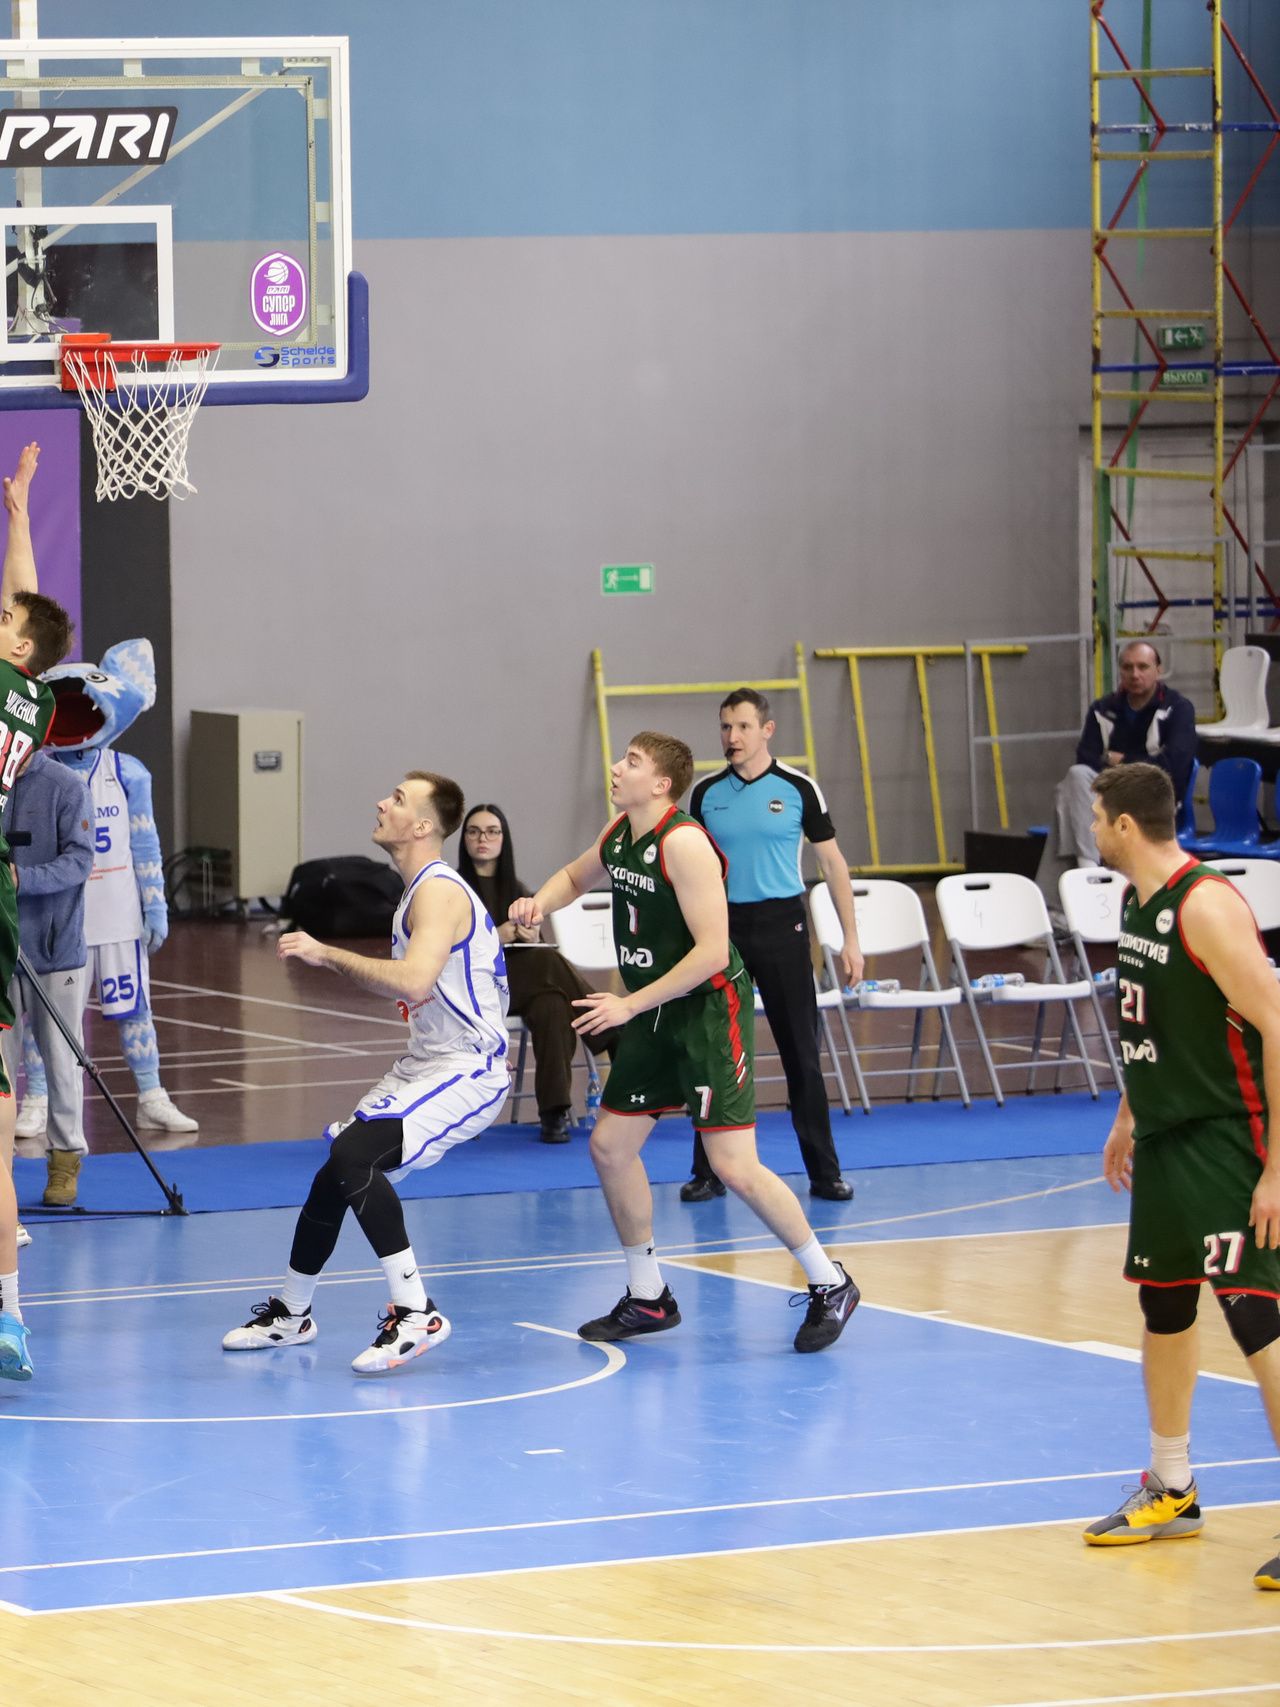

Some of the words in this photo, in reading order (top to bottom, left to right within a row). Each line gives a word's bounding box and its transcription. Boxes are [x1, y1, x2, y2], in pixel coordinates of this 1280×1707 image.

[262, 295, 296, 313] СУПЕР
[270, 313, 289, 326] ЛИГА
[280, 346, 335, 356] Schelde
[280, 356, 336, 367] Sports
[1162, 371, 1204, 385] ВЫХОД
[1095, 894, 1112, 919] 3
[102, 974, 135, 1004] 25
[1119, 978, 1145, 1024] 27
[1203, 1231, 1245, 1276] 27
